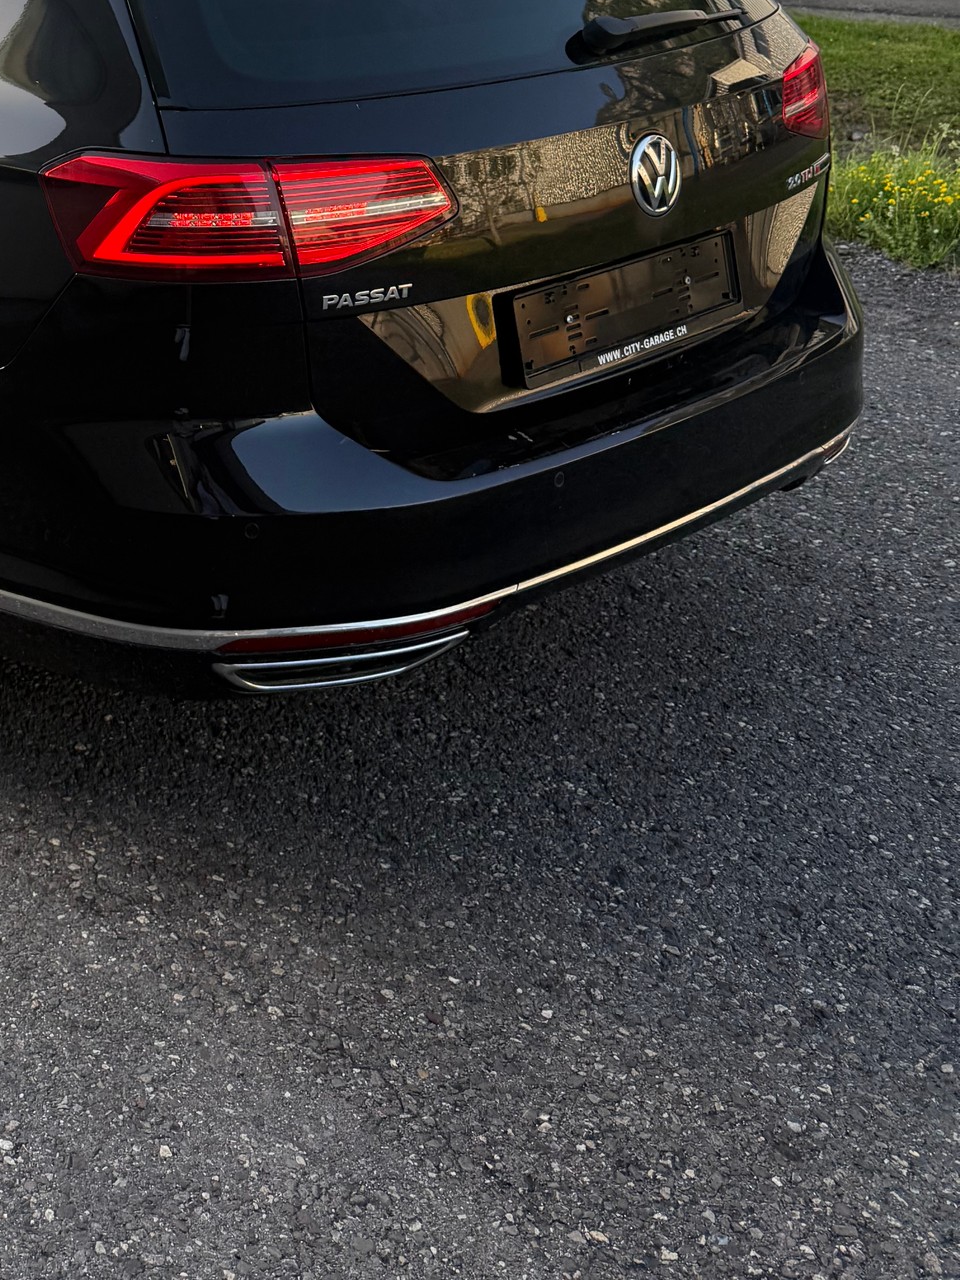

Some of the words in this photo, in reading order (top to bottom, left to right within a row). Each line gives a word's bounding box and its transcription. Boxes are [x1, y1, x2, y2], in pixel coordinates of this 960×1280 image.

[636, 137, 678, 211] VW
[322, 283, 413, 310] PASSAT
[597, 325, 688, 365] WWW.CITY-GARAGE.CH
